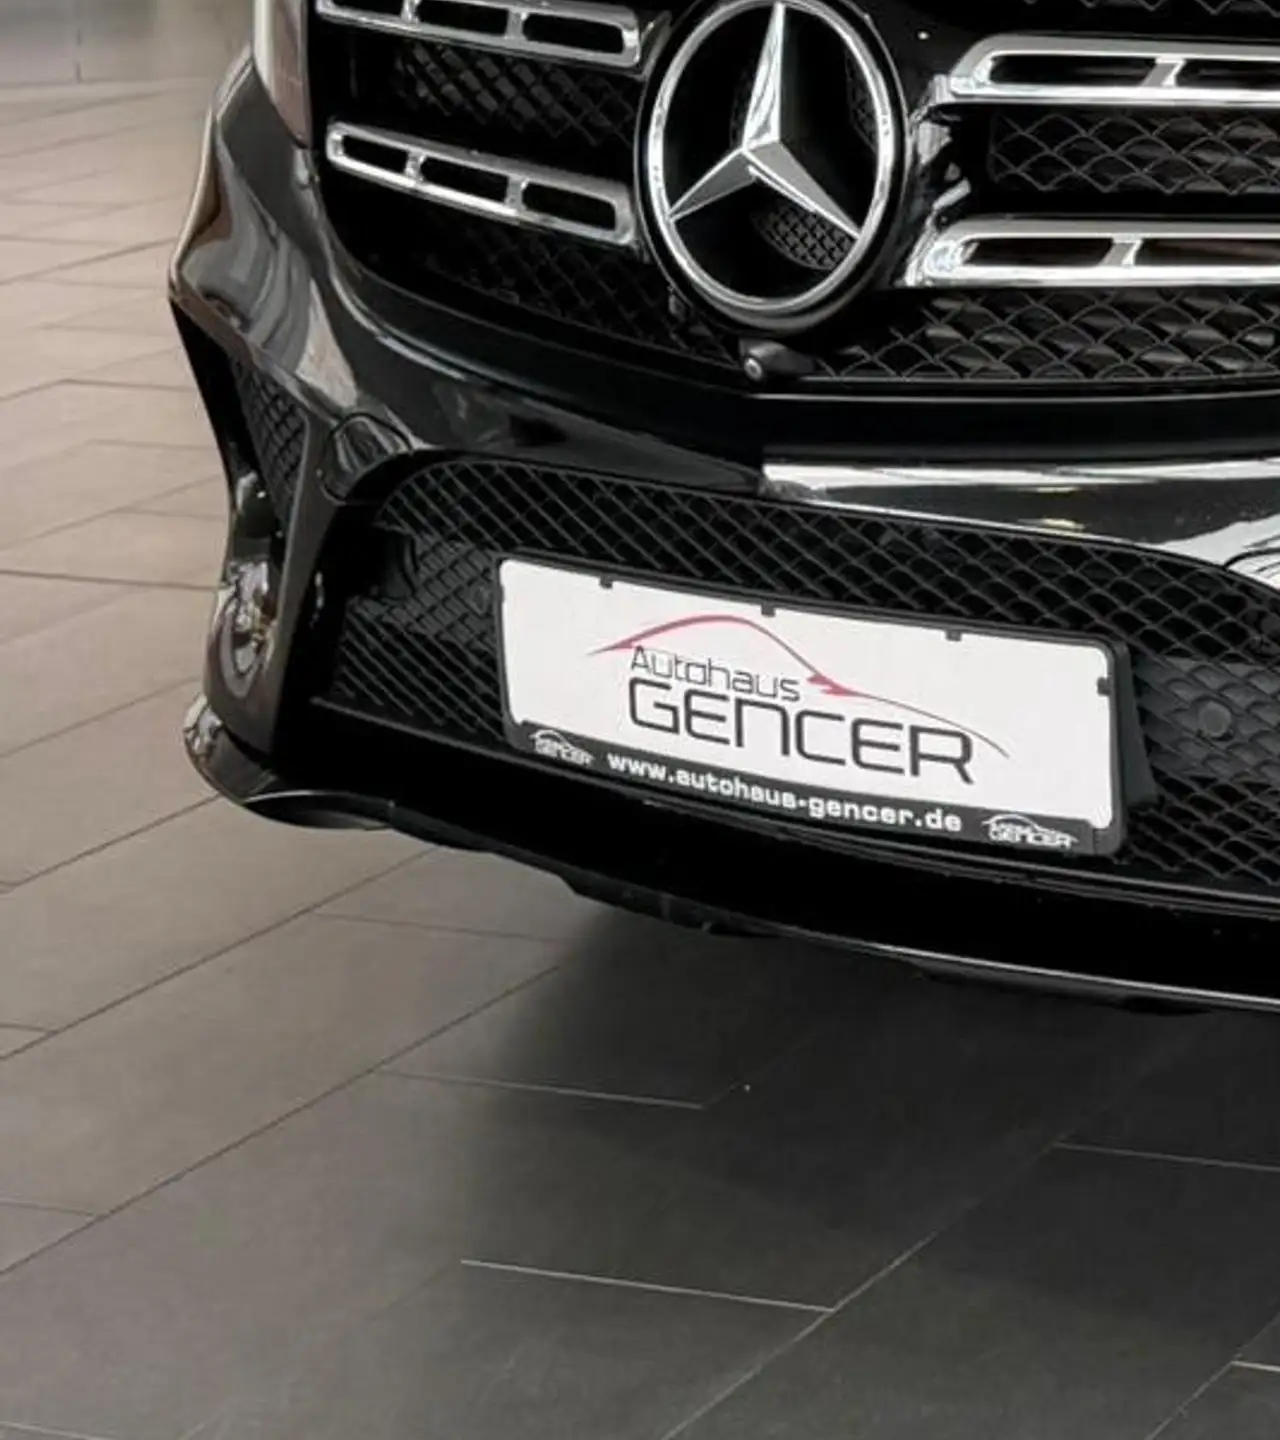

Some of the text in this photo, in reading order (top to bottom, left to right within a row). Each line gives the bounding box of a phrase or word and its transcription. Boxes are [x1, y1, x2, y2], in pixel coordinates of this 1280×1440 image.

[630, 645, 800, 703] Autohaus
[628, 676, 974, 784] GENCER
[607, 750, 962, 833] www.autohaus-gencer.de
